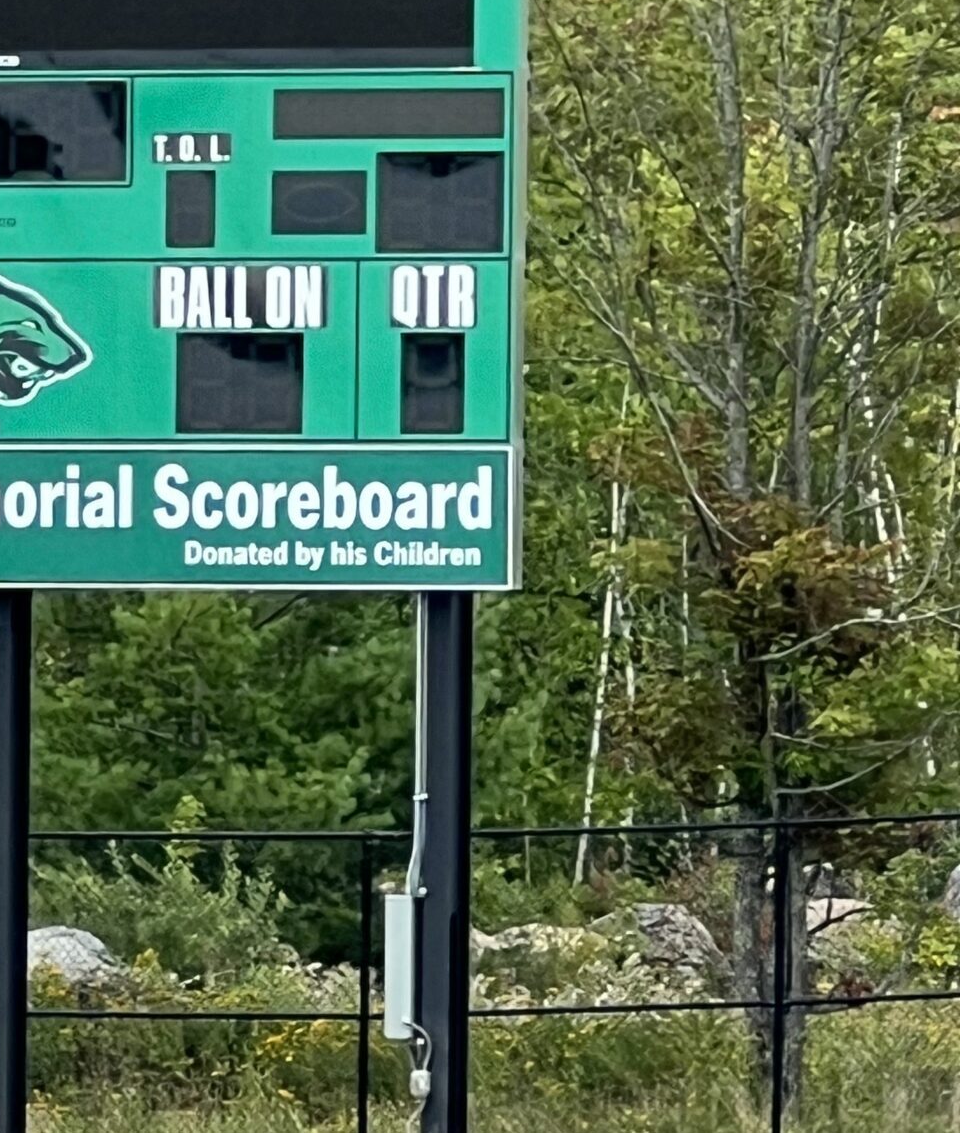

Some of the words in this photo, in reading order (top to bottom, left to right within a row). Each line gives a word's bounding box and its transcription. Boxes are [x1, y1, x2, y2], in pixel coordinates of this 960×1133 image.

[160, 266, 253, 328] BALL
[265, 266, 322, 328] ON
[392, 266, 475, 328] QTR
[153, 463, 493, 529] Scoreboard
[184, 540, 288, 566] Donated
[294, 540, 326, 571] by
[330, 540, 367, 566] his
[373, 541, 481, 567] Children
